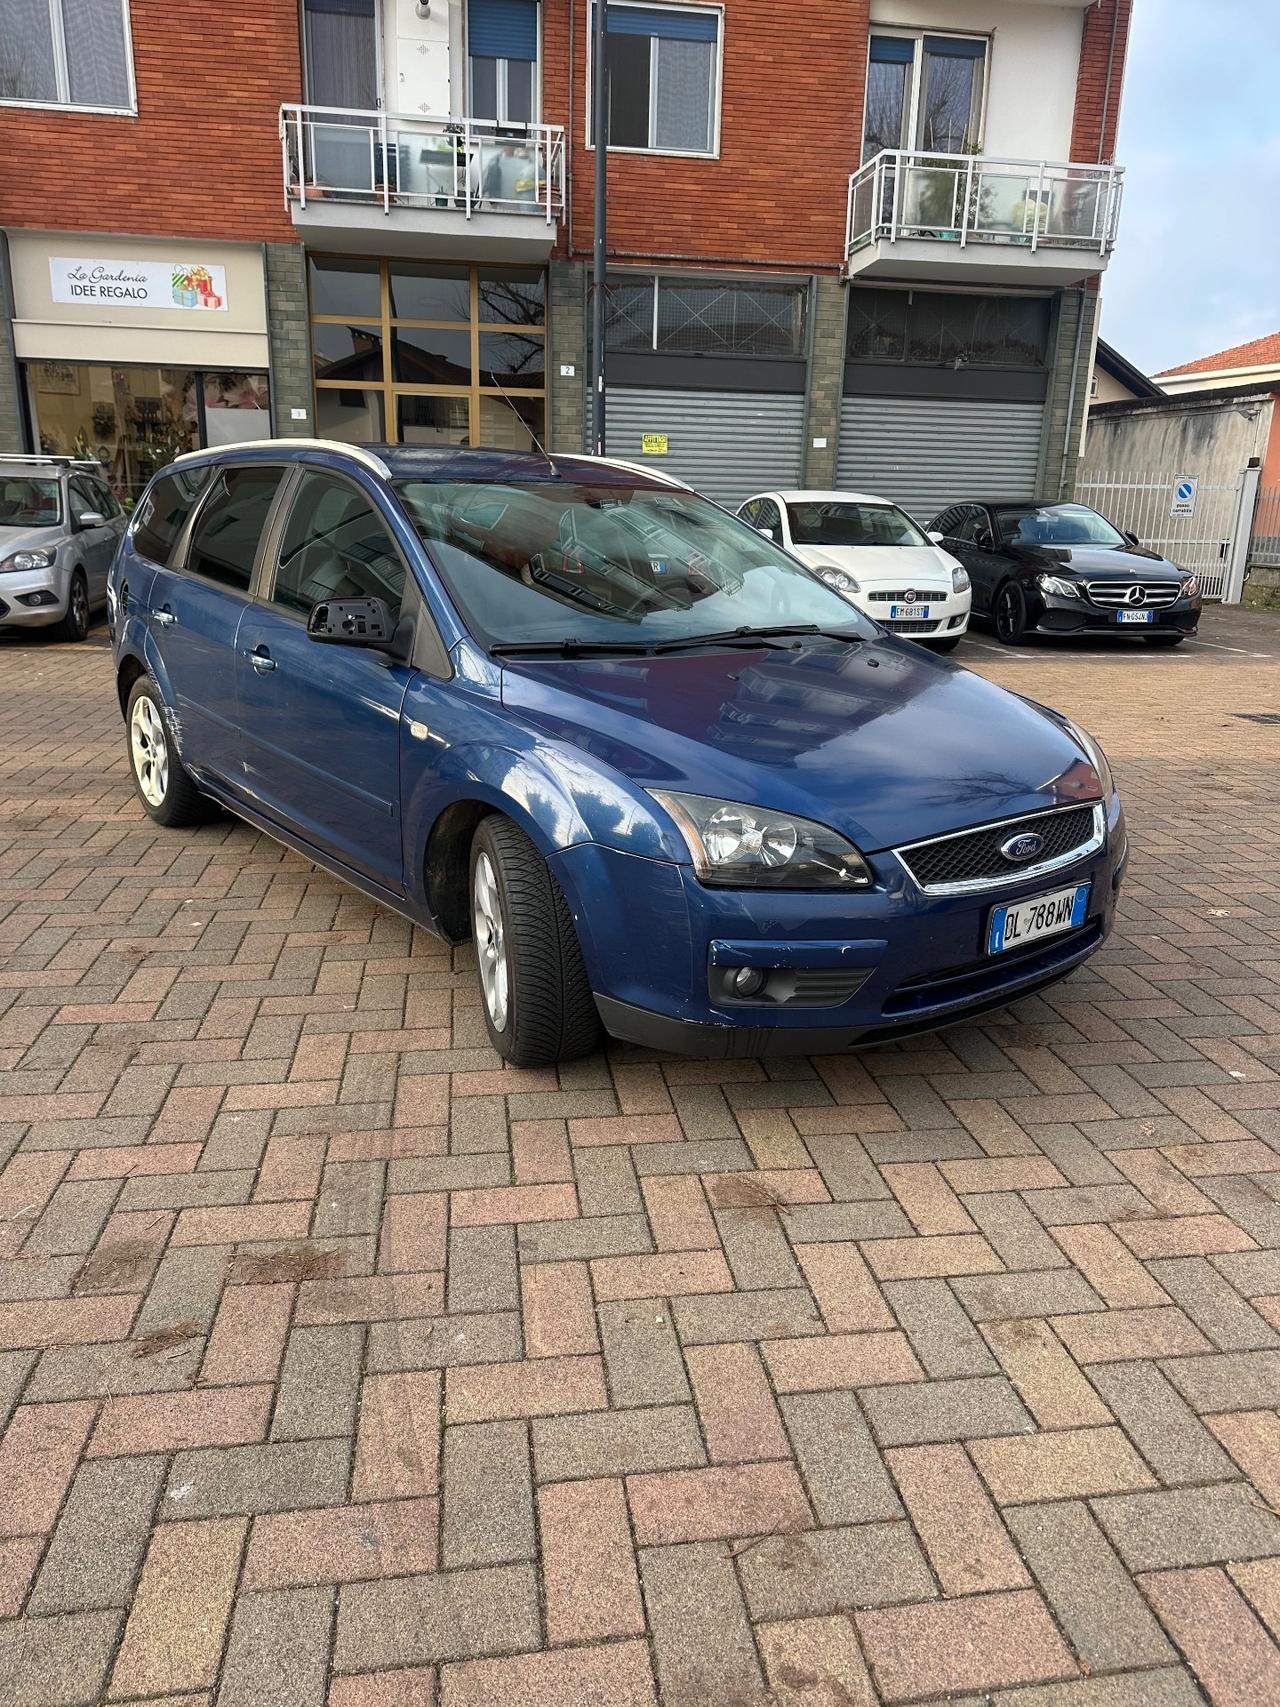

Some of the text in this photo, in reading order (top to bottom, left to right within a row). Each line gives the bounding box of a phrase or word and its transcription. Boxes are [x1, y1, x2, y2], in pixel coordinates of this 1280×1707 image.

[67, 265, 148, 284] La Gardenia
[70, 284, 148, 299] IDEE REGALO
[1016, 838, 1037, 856] Ford
